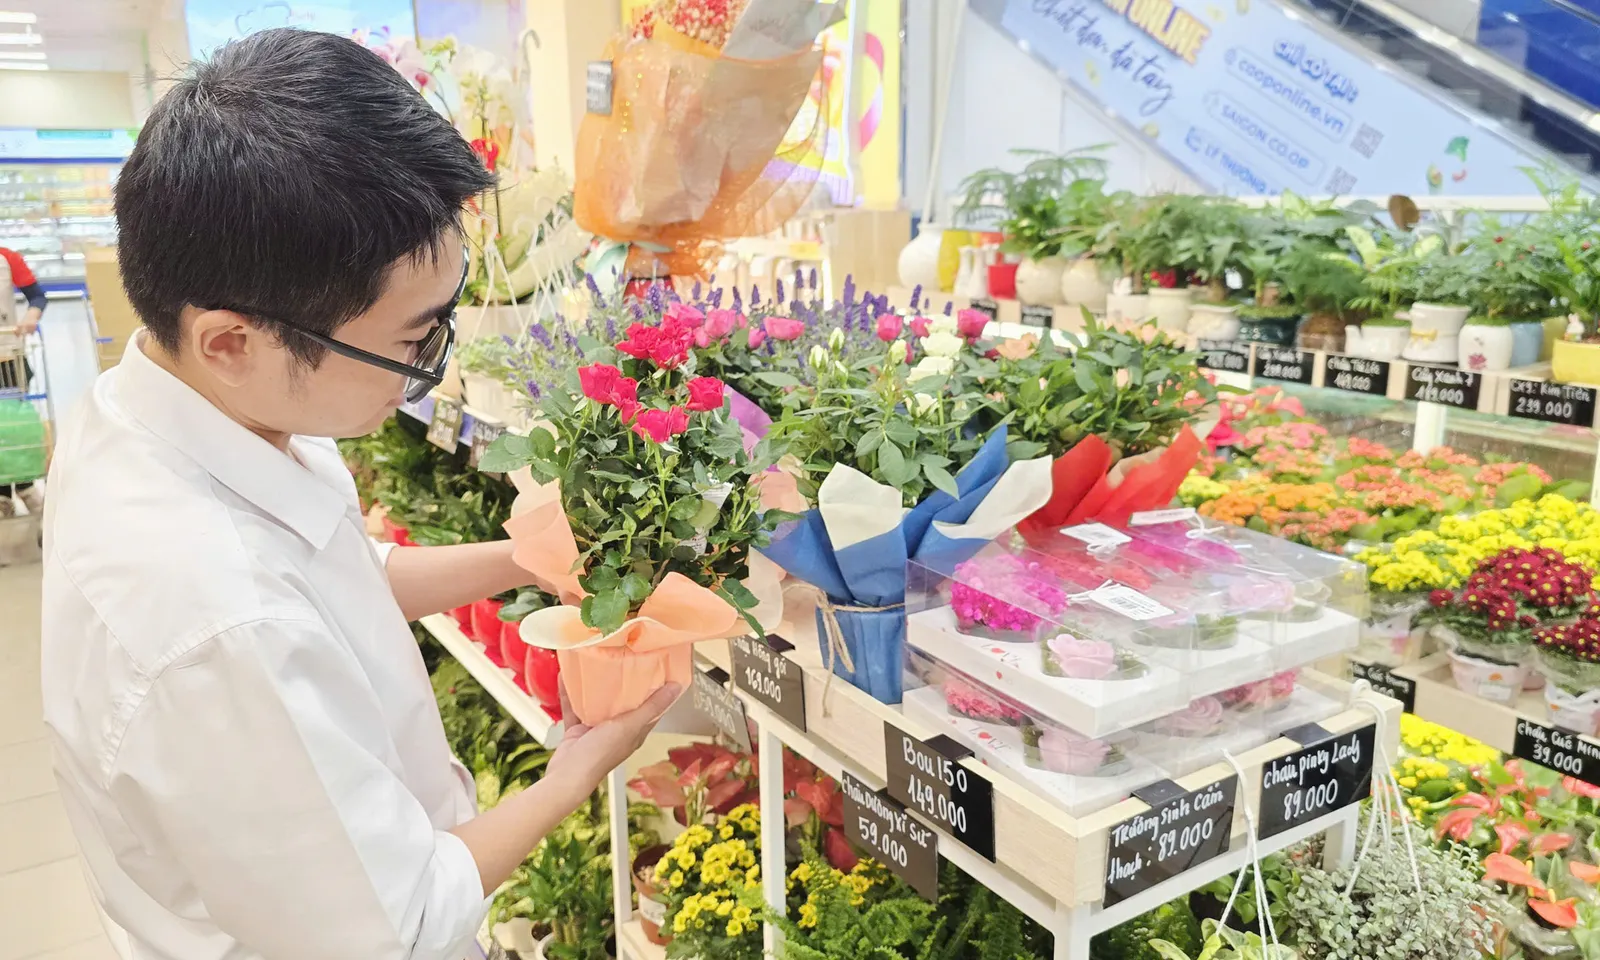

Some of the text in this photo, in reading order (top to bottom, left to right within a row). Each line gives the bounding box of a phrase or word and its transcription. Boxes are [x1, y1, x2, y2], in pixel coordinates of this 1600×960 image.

[1132, 55, 1176, 117] tay
[1238, 59, 1344, 134] cooponline.vn
[1221, 104, 1268, 142] SAIGON
[1516, 396, 1573, 418] 239.000
[1540, 382, 1561, 398] Kim
[745, 666, 782, 704] 169.000
[903, 737, 968, 793] Bou 150
[1331, 733, 1360, 764] Lady
[1532, 743, 1582, 775] 39.000
[908, 774, 967, 833] 149.000
[1284, 778, 1338, 821] 89.000
[858, 816, 908, 867] 59.000
[1158, 818, 1214, 862] 89.000
